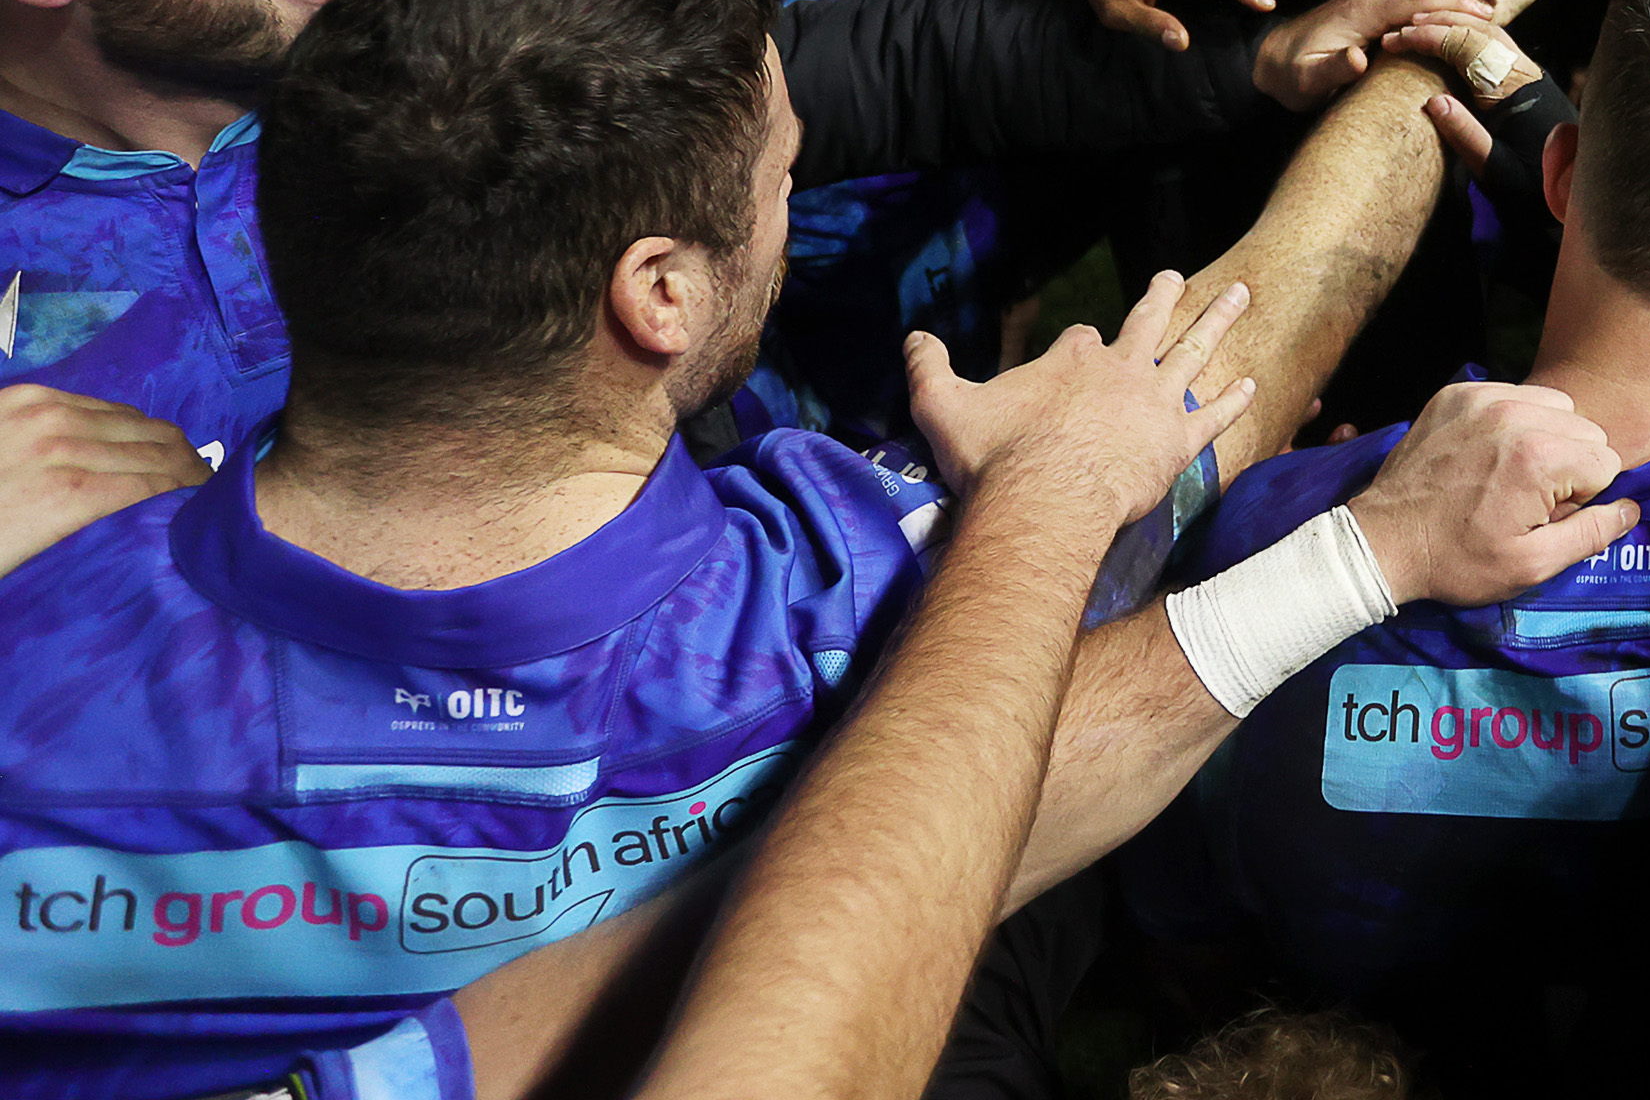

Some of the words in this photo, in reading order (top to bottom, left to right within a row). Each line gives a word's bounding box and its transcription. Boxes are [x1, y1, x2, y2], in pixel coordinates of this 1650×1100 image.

[1575, 575, 1608, 585] OSPREYS
[447, 688, 526, 719] OITC
[1342, 689, 1420, 743] tch
[1430, 704, 1604, 765] group
[15, 875, 137, 933] tch
[152, 882, 389, 947] group
[409, 841, 604, 935] south
